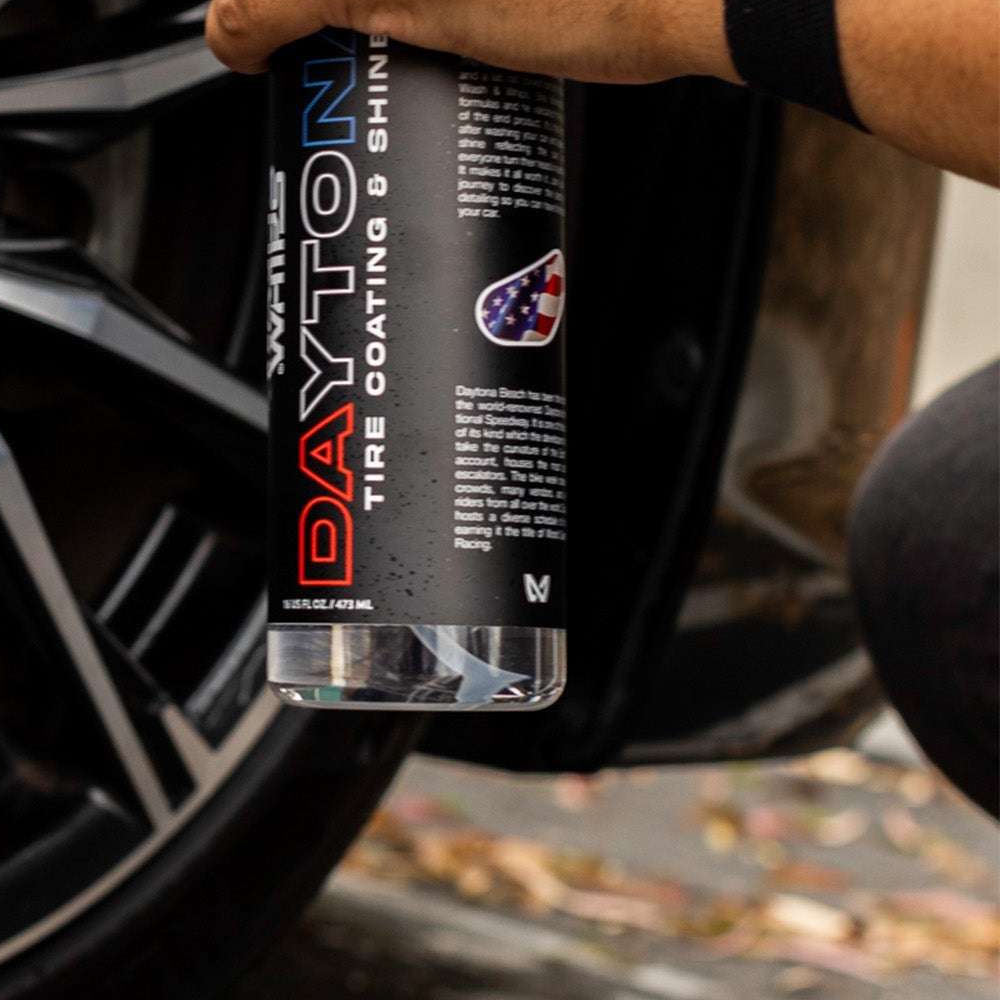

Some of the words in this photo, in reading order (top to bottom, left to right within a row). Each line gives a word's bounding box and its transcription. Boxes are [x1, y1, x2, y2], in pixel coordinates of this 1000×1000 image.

[366, 34, 389, 154] SHINE
[366, 172, 388, 198] &
[498, 181, 511, 192] to
[457, 208, 481, 219] your
[365, 217, 388, 397] COATING
[455, 384, 498, 399] Daytona
[455, 399, 474, 411] the
[455, 413, 483, 425] tional
[455, 427, 467, 438] of
[481, 441, 500, 453] the
[363, 415, 386, 511] TIRE
[454, 537, 493, 552] Racing.
[336, 598, 355, 611] 473
[355, 598, 375, 611] ML
